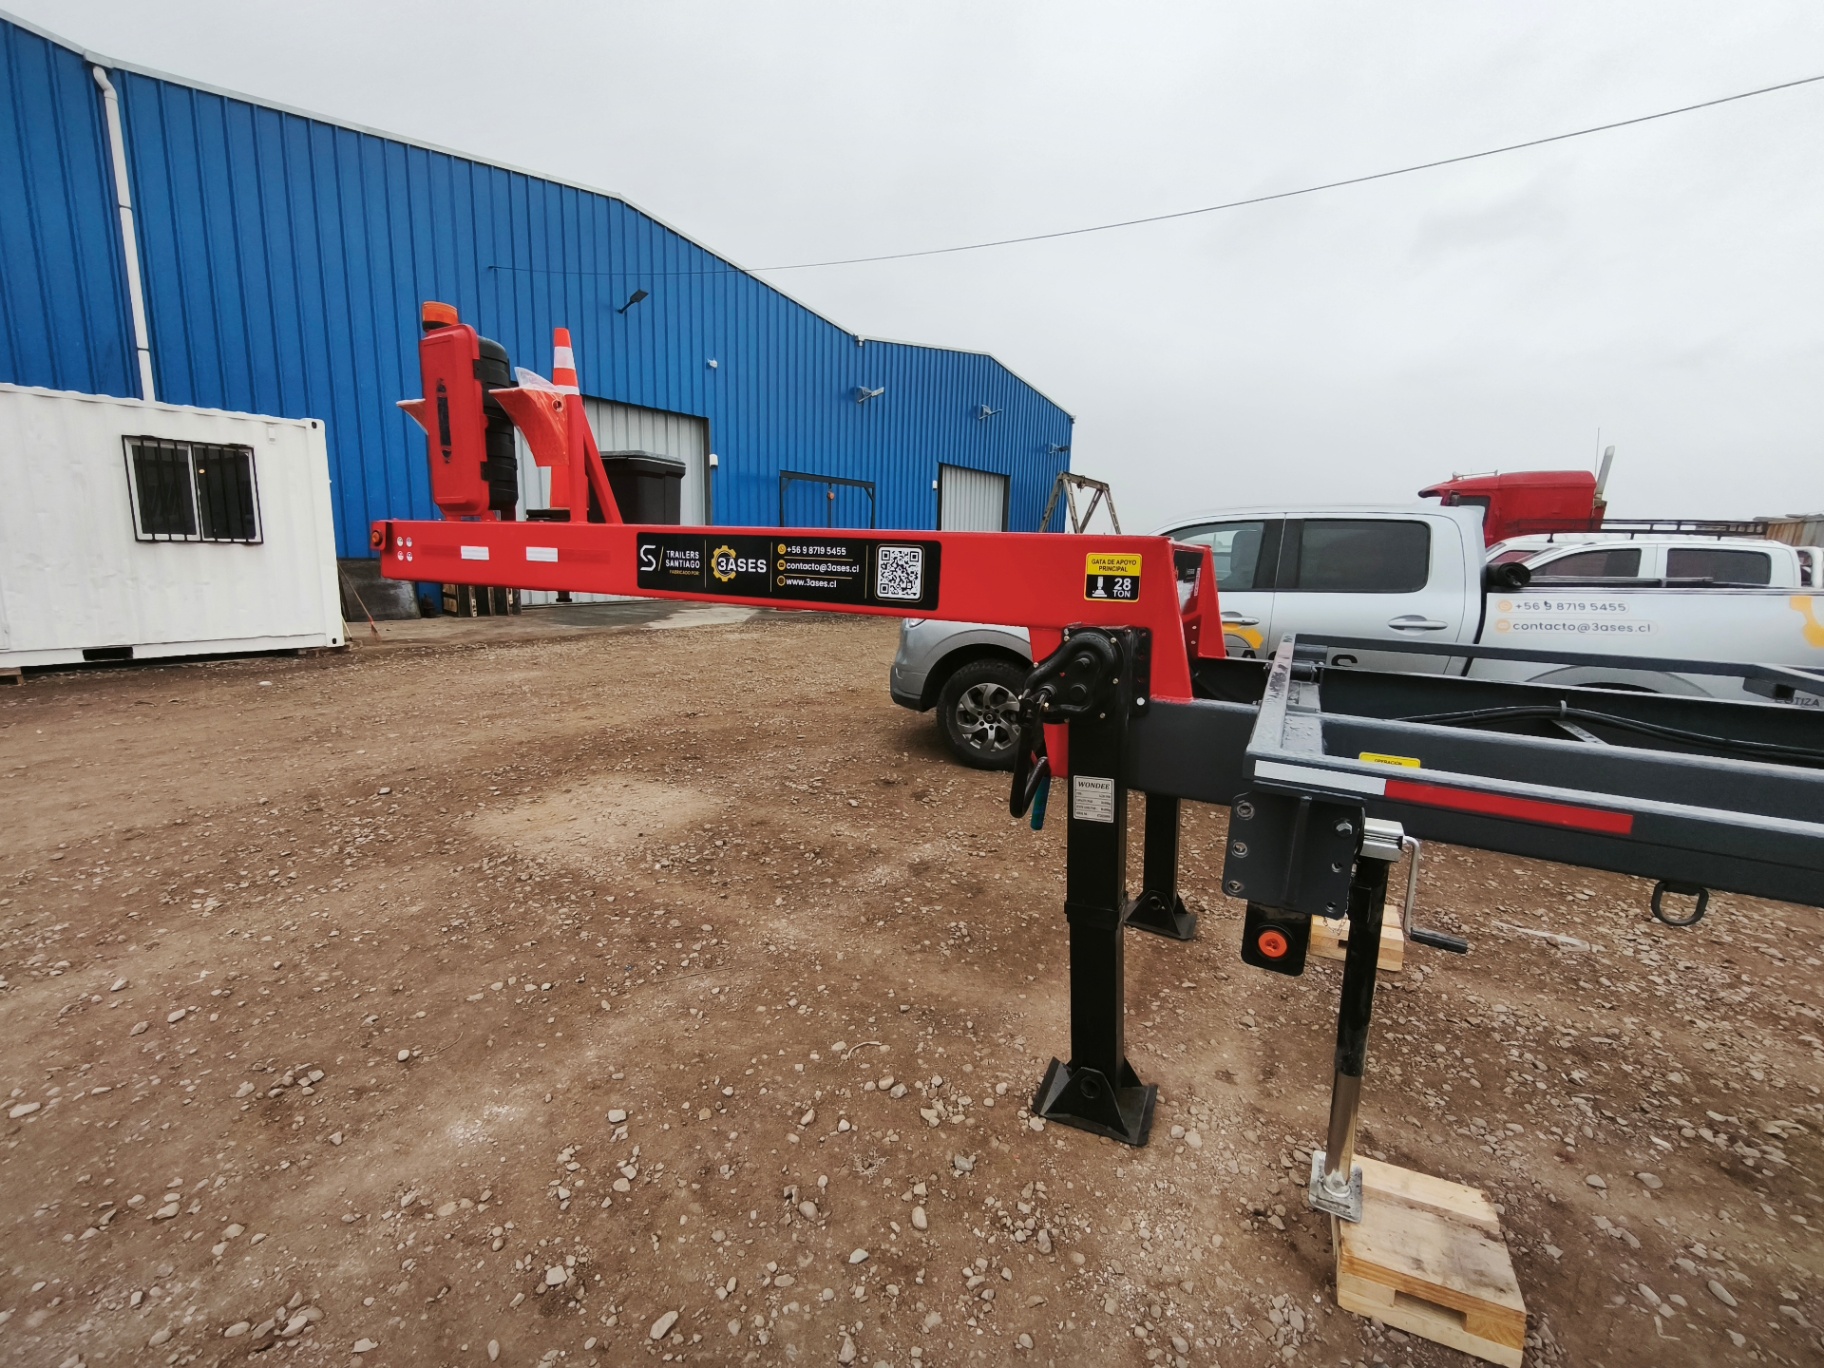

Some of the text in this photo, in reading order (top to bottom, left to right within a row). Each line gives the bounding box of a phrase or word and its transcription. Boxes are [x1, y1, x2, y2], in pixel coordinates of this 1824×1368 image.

[666, 550, 699, 560] TRAILERS
[787, 545, 847, 556] +56 9 8719 5455
[665, 559, 700, 569] SANTIAGO
[717, 557, 767, 573] 3ASES
[786, 562, 860, 573] contacto@3ases.cl
[1098, 565, 1128, 573] PRINCIPAL
[786, 578, 837, 588] www.3ases.cl
[1113, 577, 1132, 591] 28
[1112, 589, 1131, 598] TON
[1516, 602, 1626, 612] +56 9 8719 5455
[1512, 622, 1651, 633] contacto@3ases.cl
